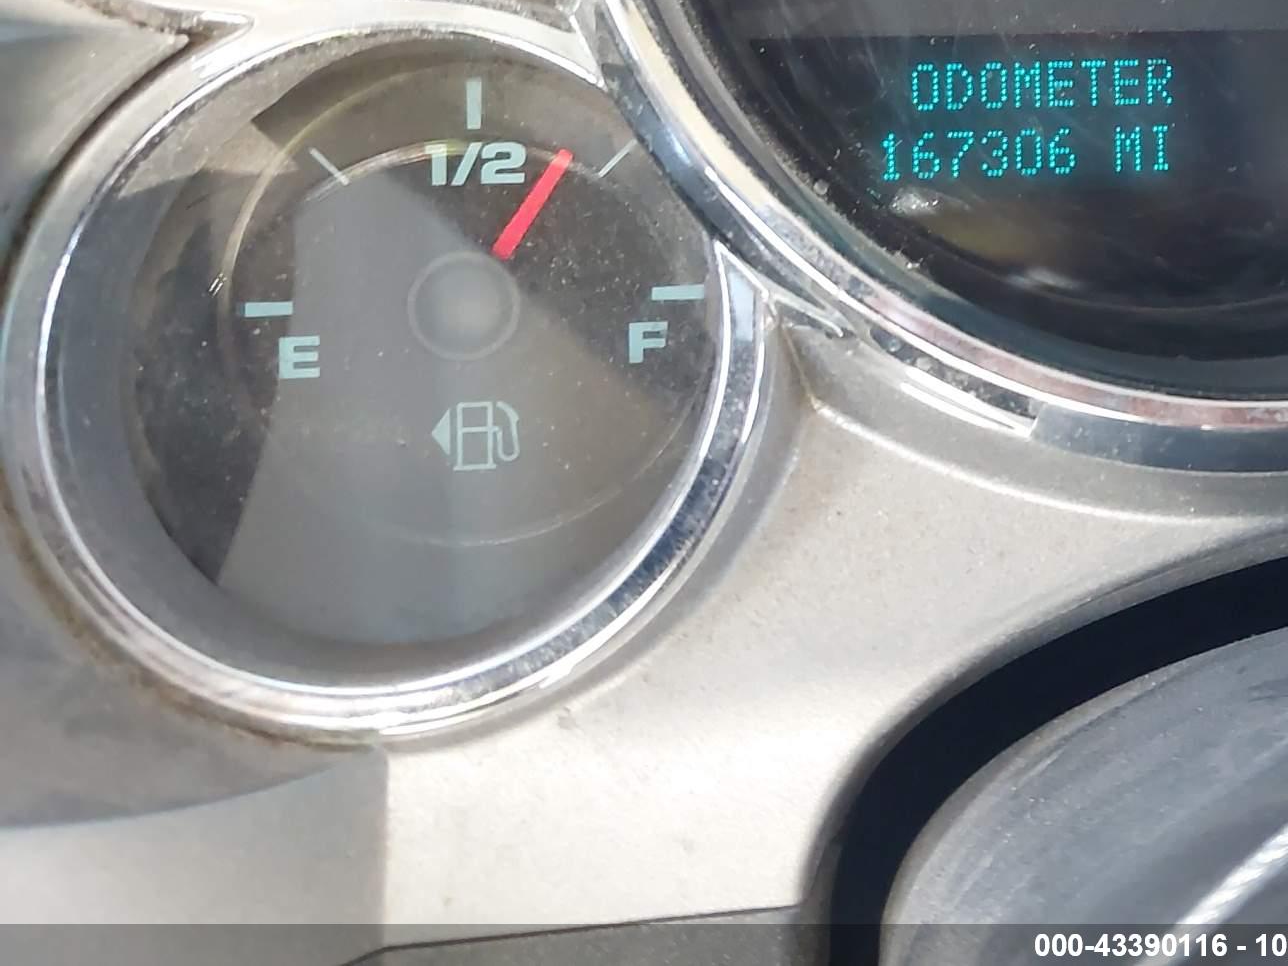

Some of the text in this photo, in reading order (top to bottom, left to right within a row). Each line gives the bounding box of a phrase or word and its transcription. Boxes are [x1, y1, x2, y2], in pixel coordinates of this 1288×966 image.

[911, 59, 1173, 111] ODOMETER
[424, 141, 526, 186] 1/2
[881, 125, 1169, 180] 167306 MI
[278, 336, 321, 379] E
[628, 321, 669, 363] F
